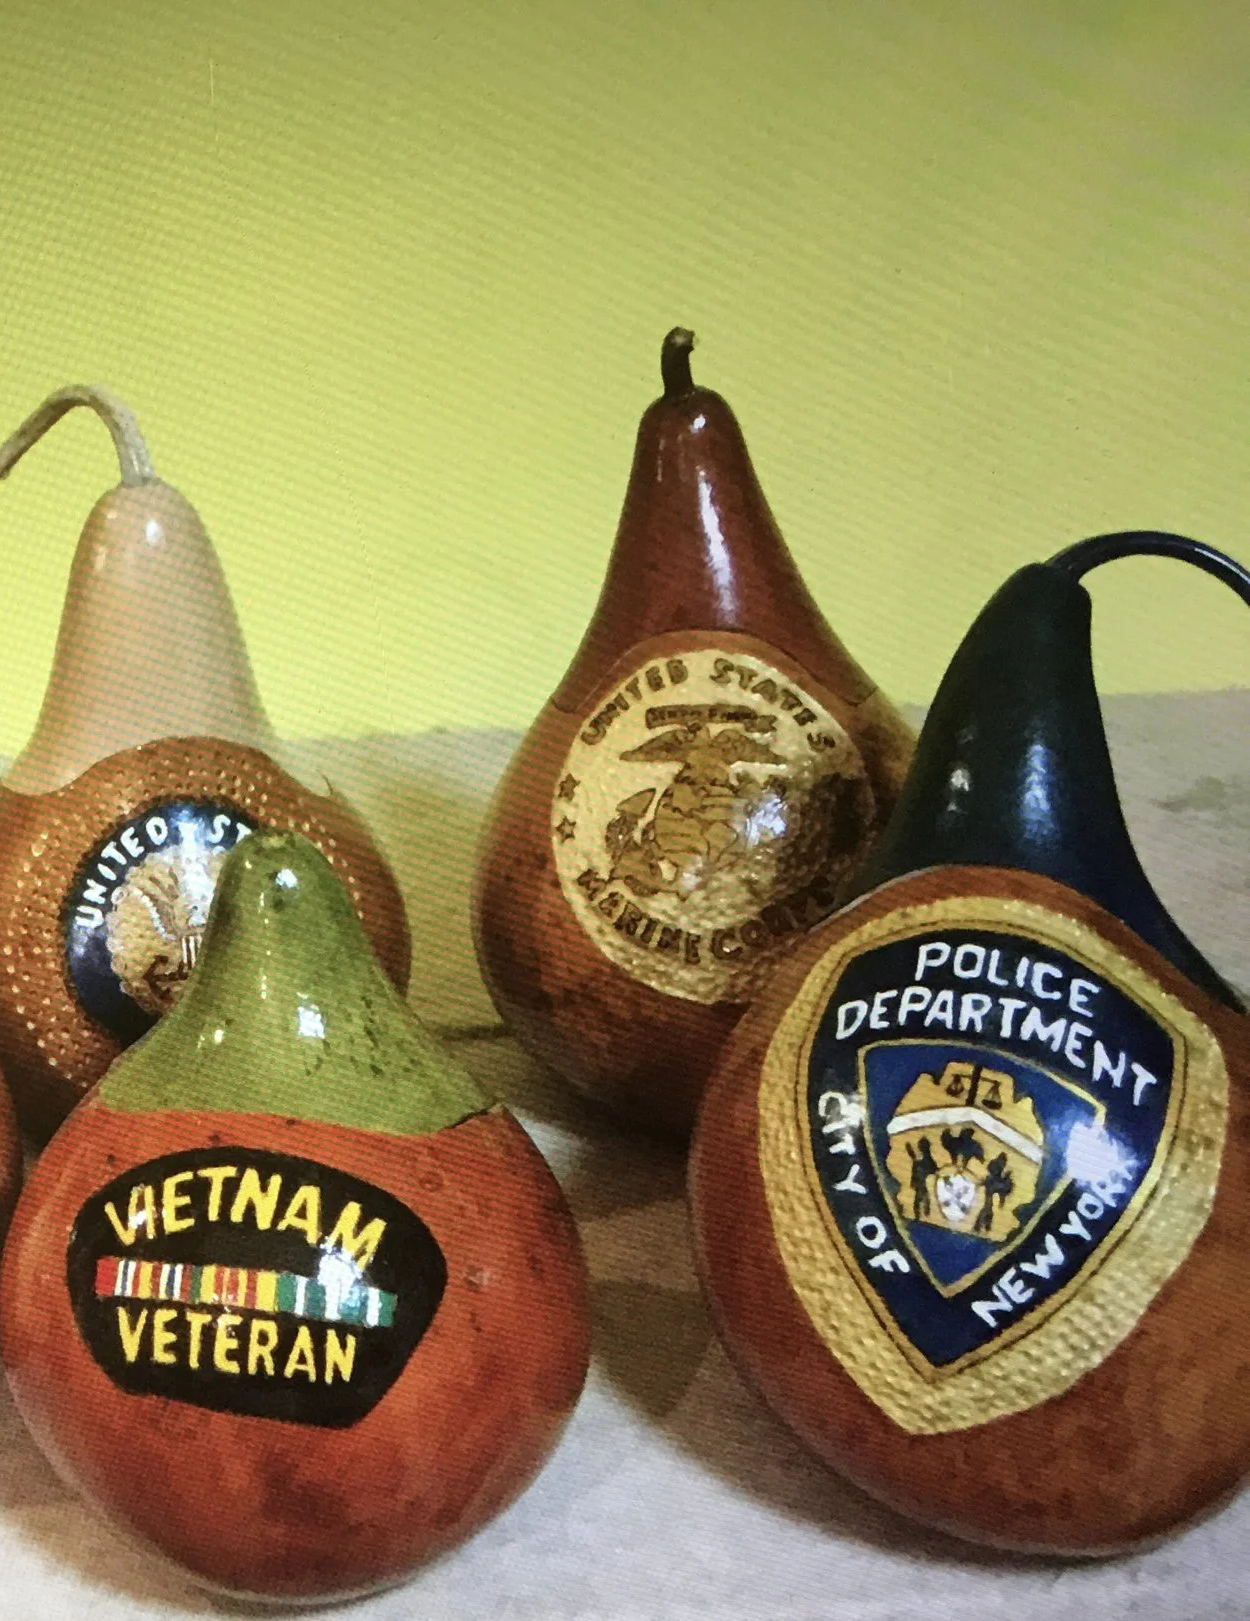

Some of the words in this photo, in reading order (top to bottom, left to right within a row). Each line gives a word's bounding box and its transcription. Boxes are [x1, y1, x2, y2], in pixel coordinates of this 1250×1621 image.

[581, 659, 689, 745] UNITED
[710, 657, 836, 752] STATES
[914, 941, 1100, 1018] POLICE
[836, 986, 1158, 1106] DEPARTMENT
[104, 1165, 388, 1272] VIETNAM
[818, 1090, 868, 1196] CITY
[855, 1215, 911, 1275] OF
[971, 1233, 1066, 1328] NEW
[117, 1306, 357, 1385] VETERAN
